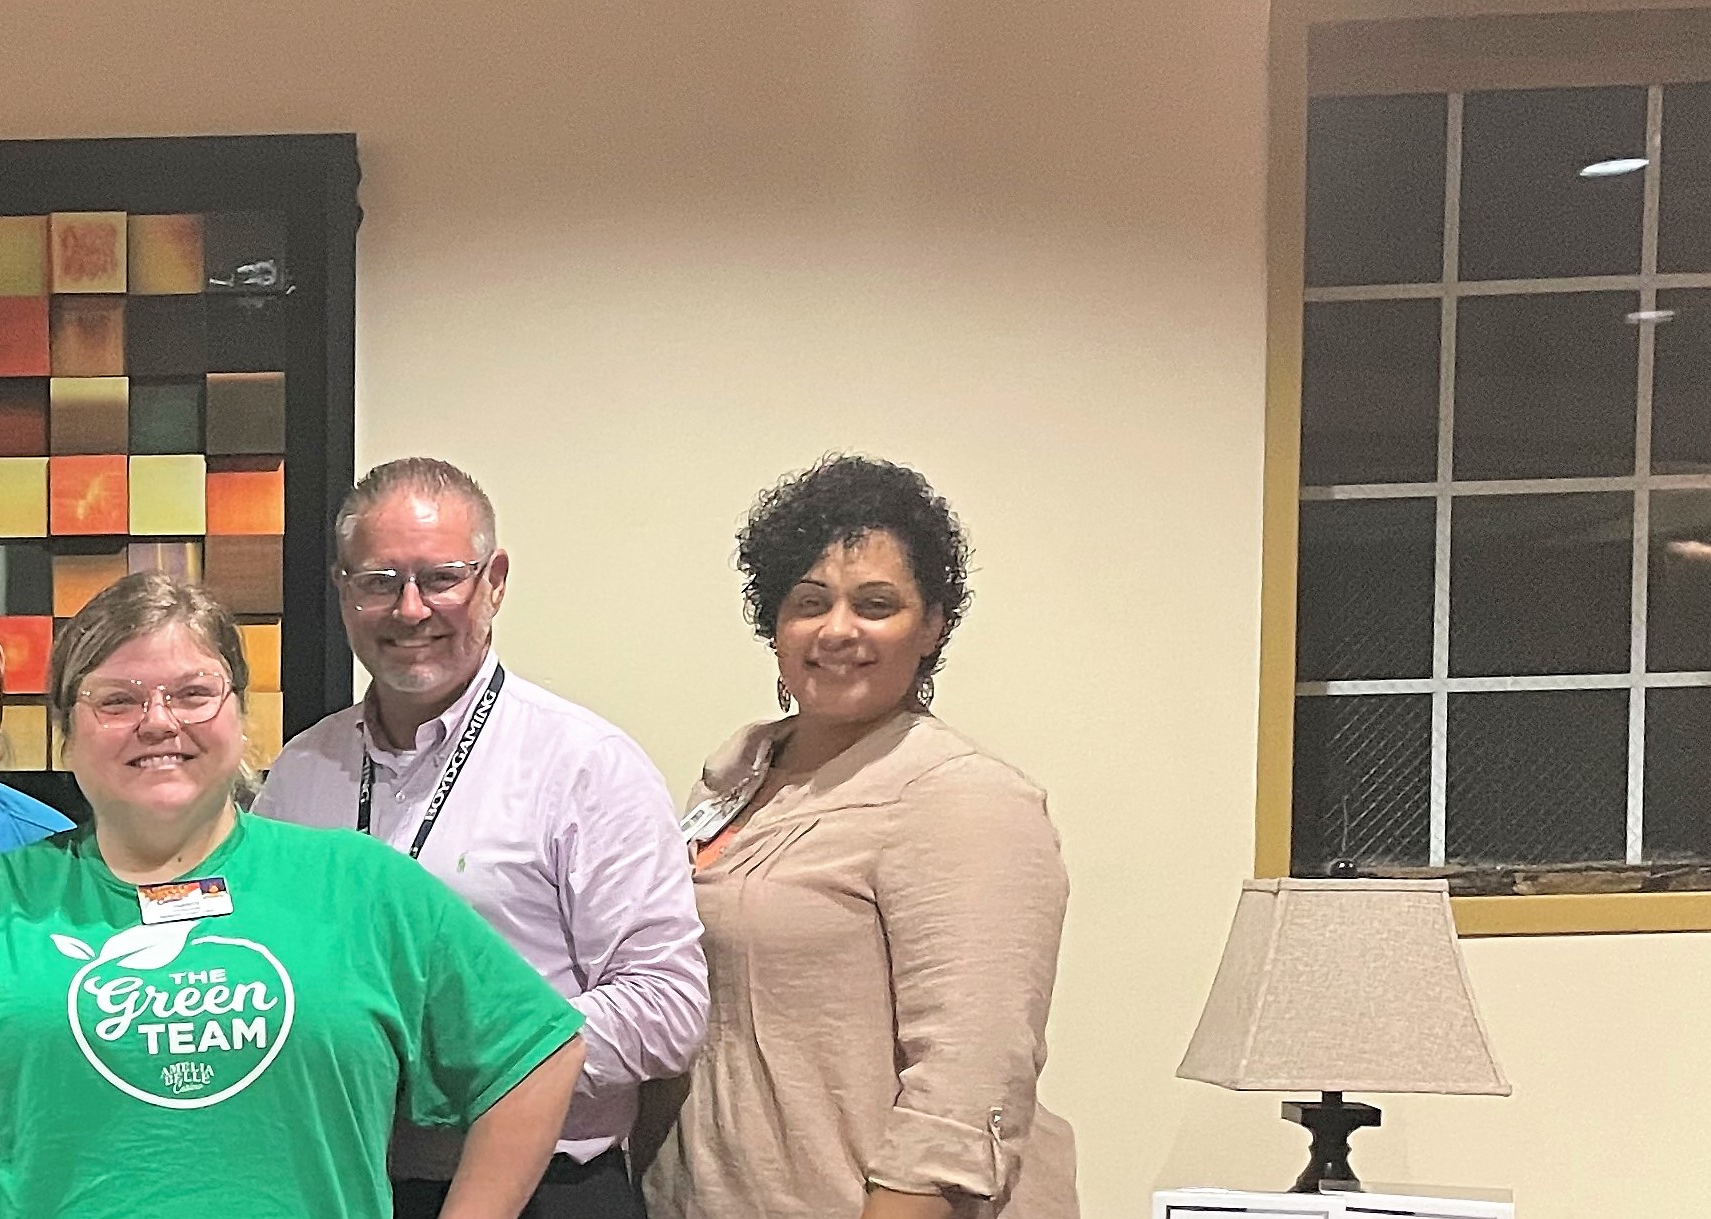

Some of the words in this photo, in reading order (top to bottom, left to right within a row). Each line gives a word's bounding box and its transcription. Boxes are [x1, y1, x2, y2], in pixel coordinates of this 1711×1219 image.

[169, 968, 226, 985] THE
[83, 976, 278, 1041] Green
[138, 1016, 267, 1055] TEAM
